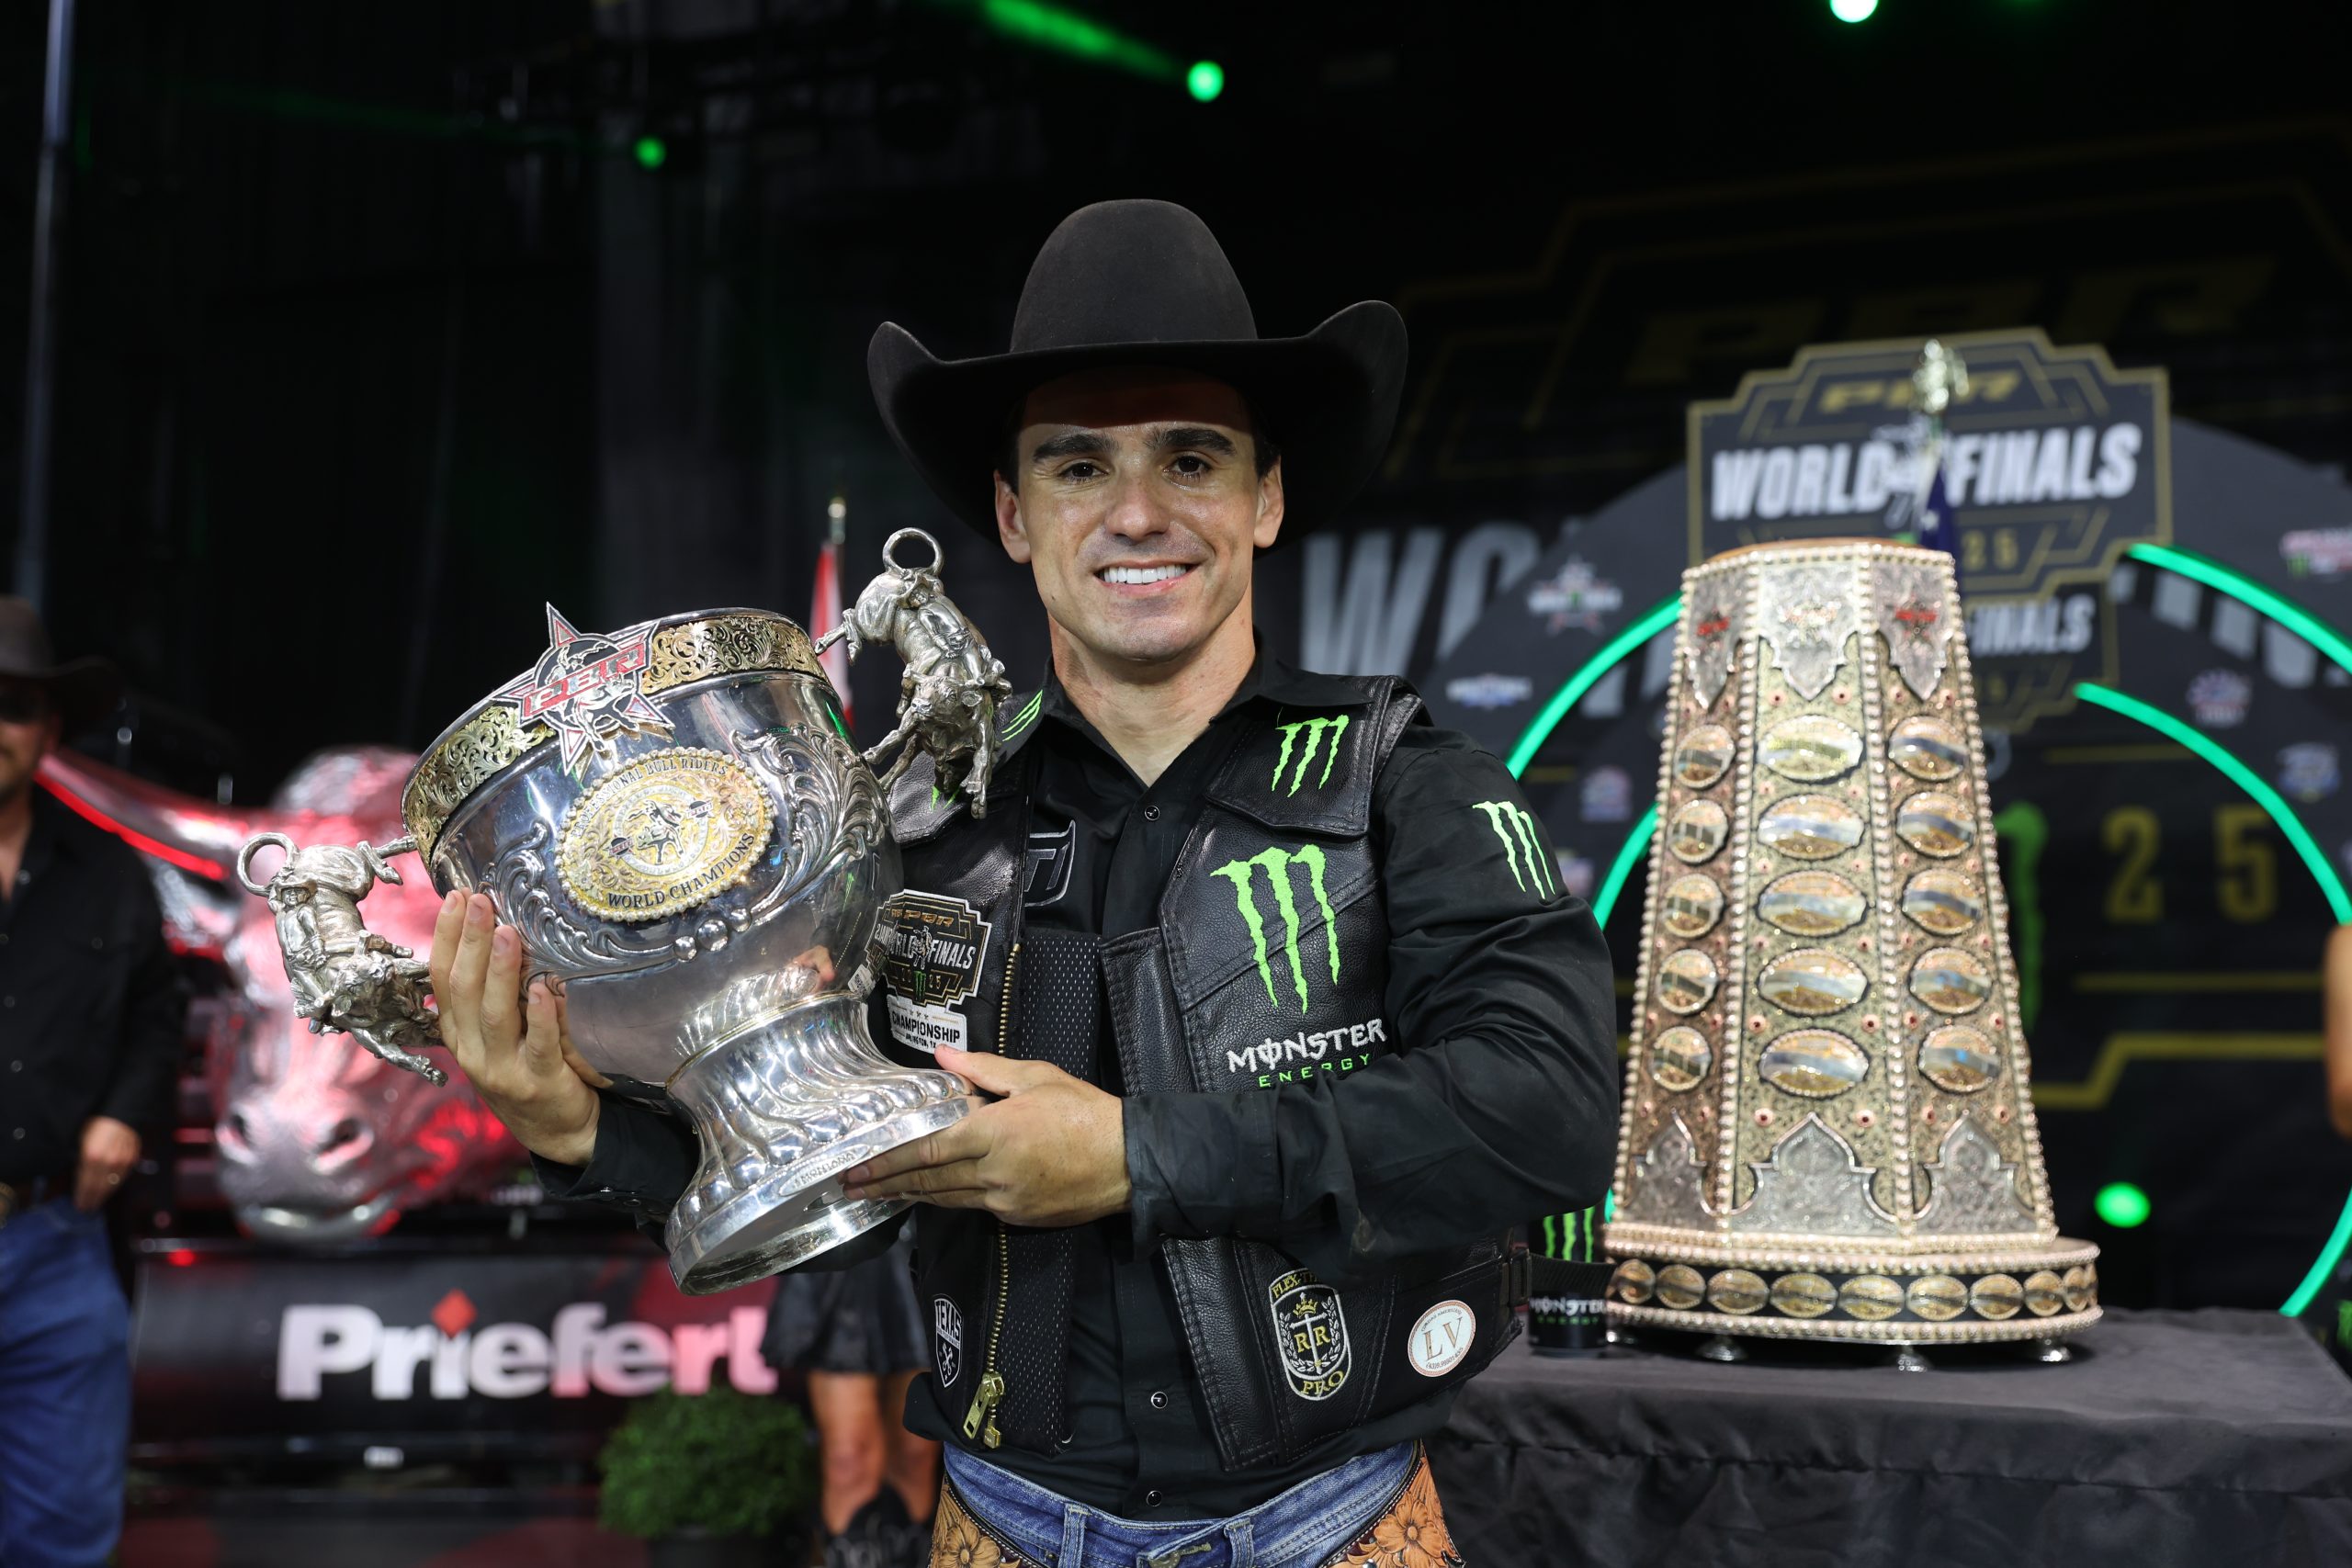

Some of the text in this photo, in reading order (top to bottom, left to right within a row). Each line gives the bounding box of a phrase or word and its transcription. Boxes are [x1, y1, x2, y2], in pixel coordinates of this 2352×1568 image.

[1710, 422, 2143, 521] WORLD FINALS
[529, 648, 640, 714] PBR
[570, 758, 729, 839] PROFESSIONAL BULL RIDERS
[607, 892, 665, 909] WORLD
[669, 832, 755, 899] CHAMPIONS
[886, 931, 917, 958] ORLD
[927, 939, 977, 970] FINALS
[892, 1010, 960, 1043] CHAMPIONSHIP
[1226, 1018, 1387, 1073] MONSTER
[1258, 1053, 1371, 1088] ENERGY
[935, 1300, 962, 1340] TEXAS
[1423, 1316, 1463, 1361] LV
[277, 1291, 778, 1401] Priefert
[1301, 1371, 1345, 1394] PRO
